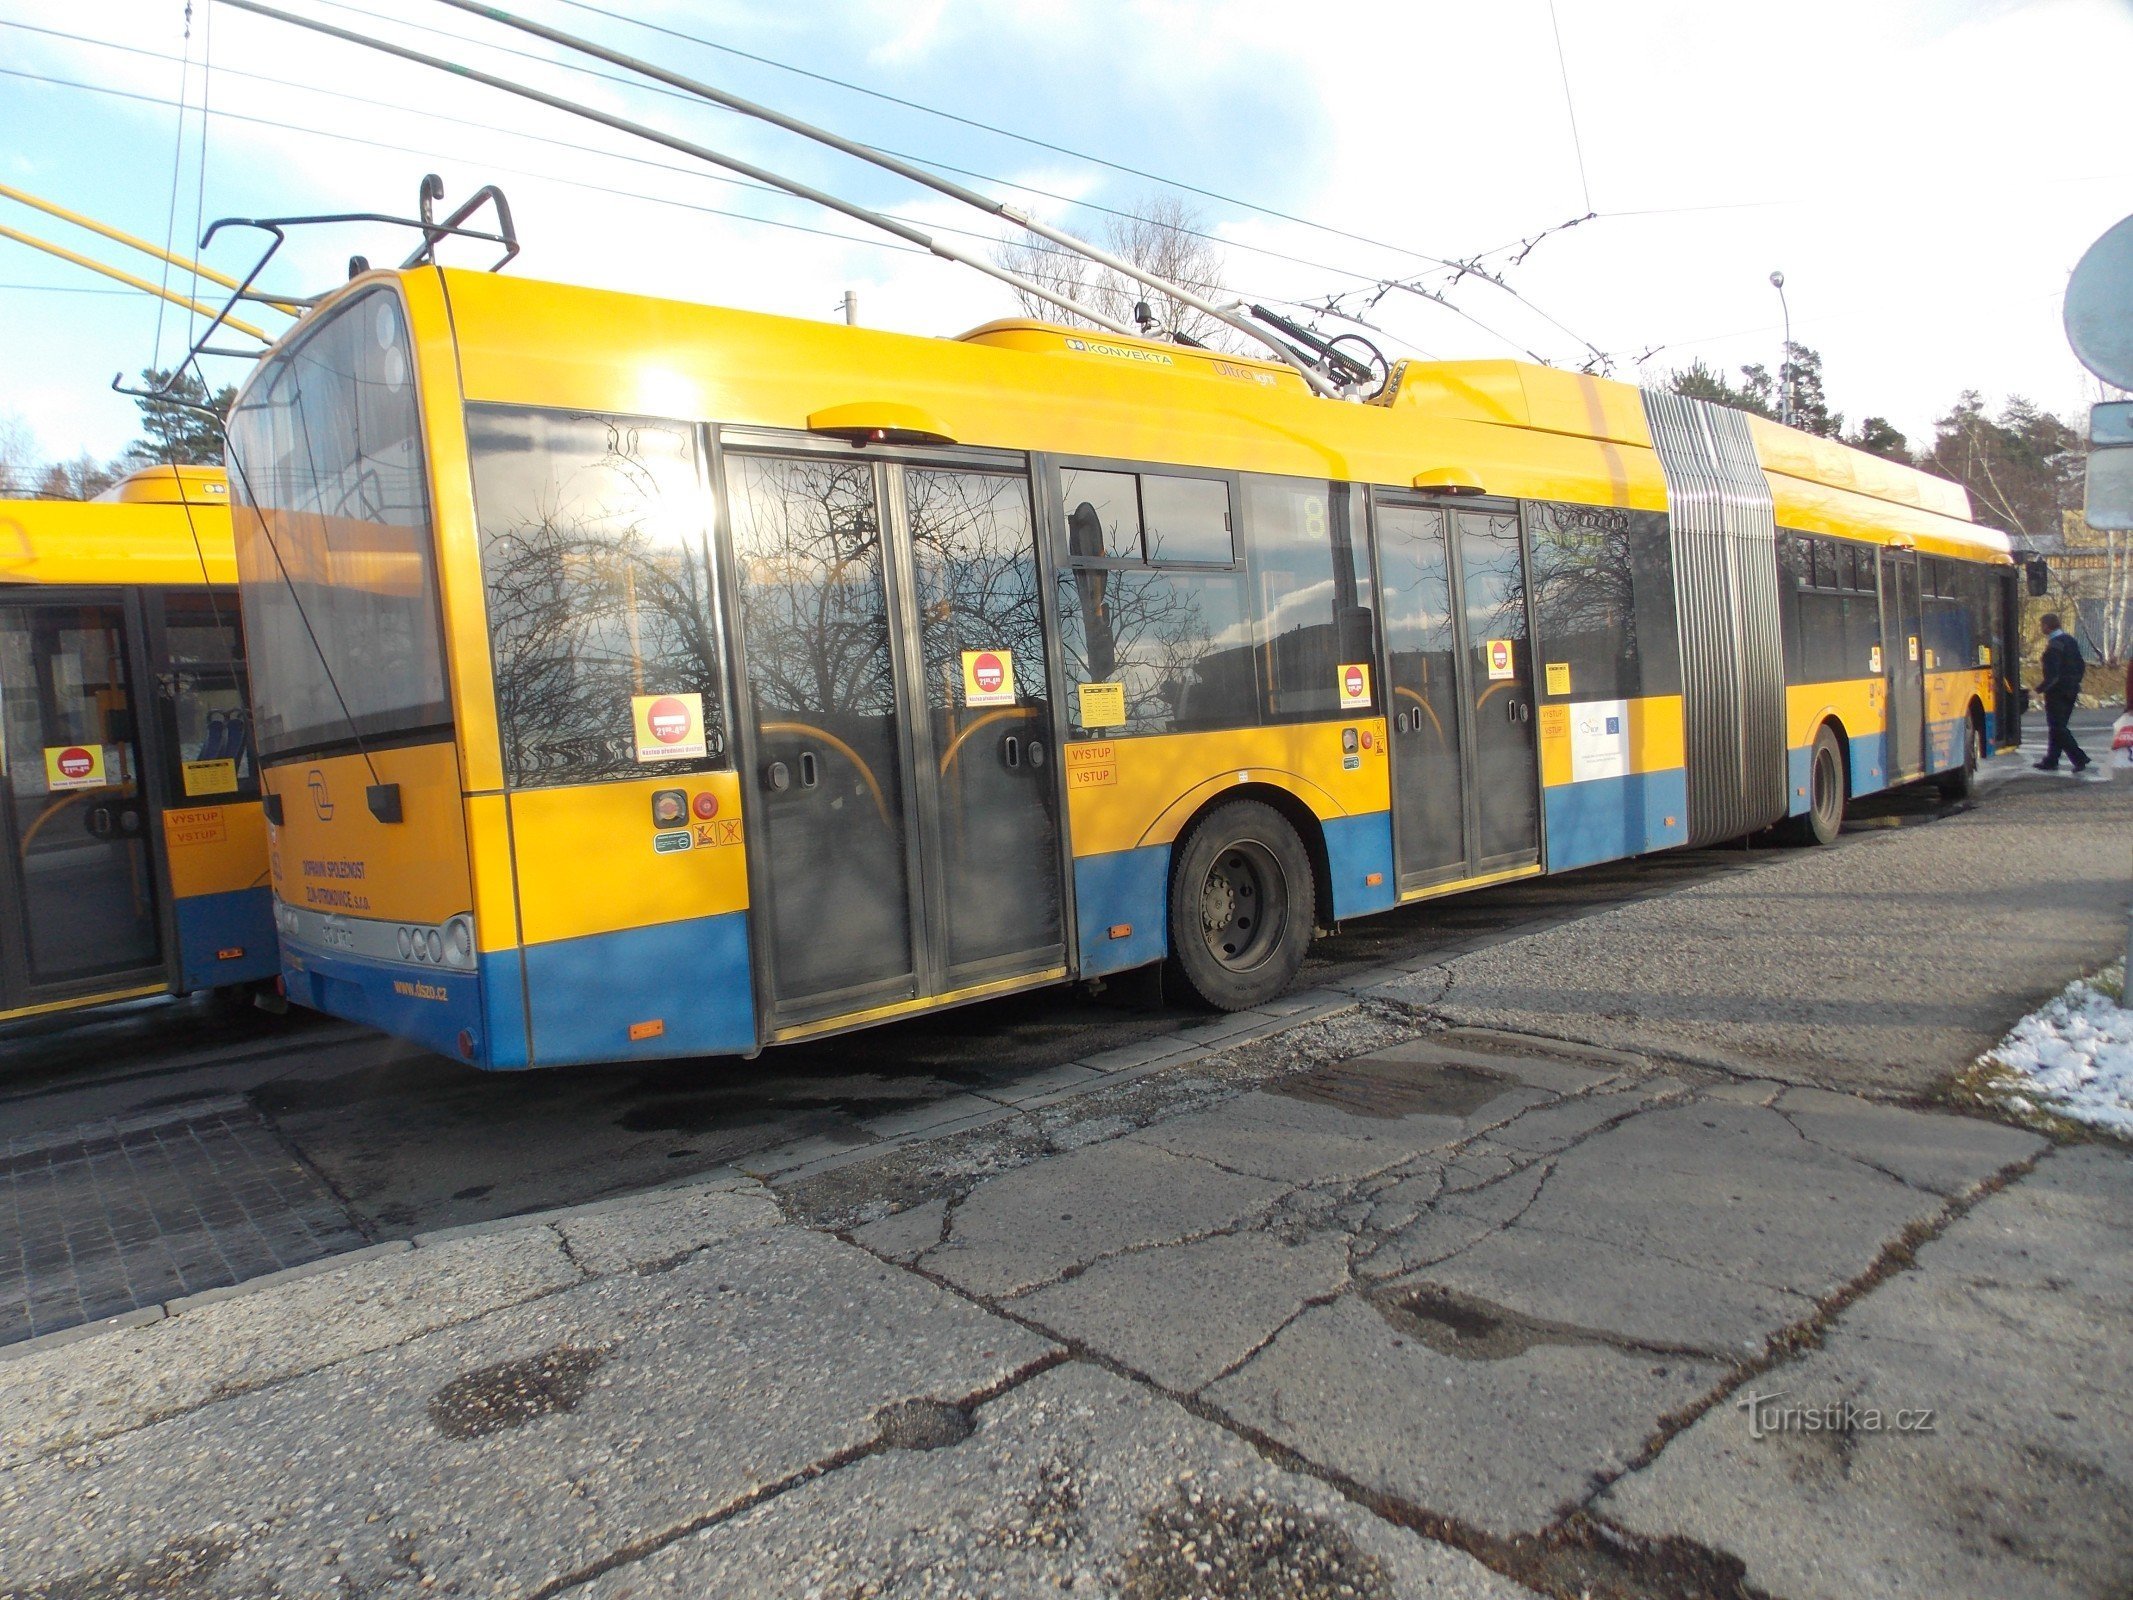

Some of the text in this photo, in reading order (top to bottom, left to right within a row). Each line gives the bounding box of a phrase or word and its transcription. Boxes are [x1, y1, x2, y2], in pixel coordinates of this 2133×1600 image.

[1086, 341, 1173, 365] KONVEKTA
[1304, 495, 1325, 539] 8
[1072, 746, 1111, 760] VÝSTUP
[1077, 770, 1110, 783] VSTUP
[177, 829, 216, 842] VSTUP
[393, 980, 448, 1001] www.dszo.cz
